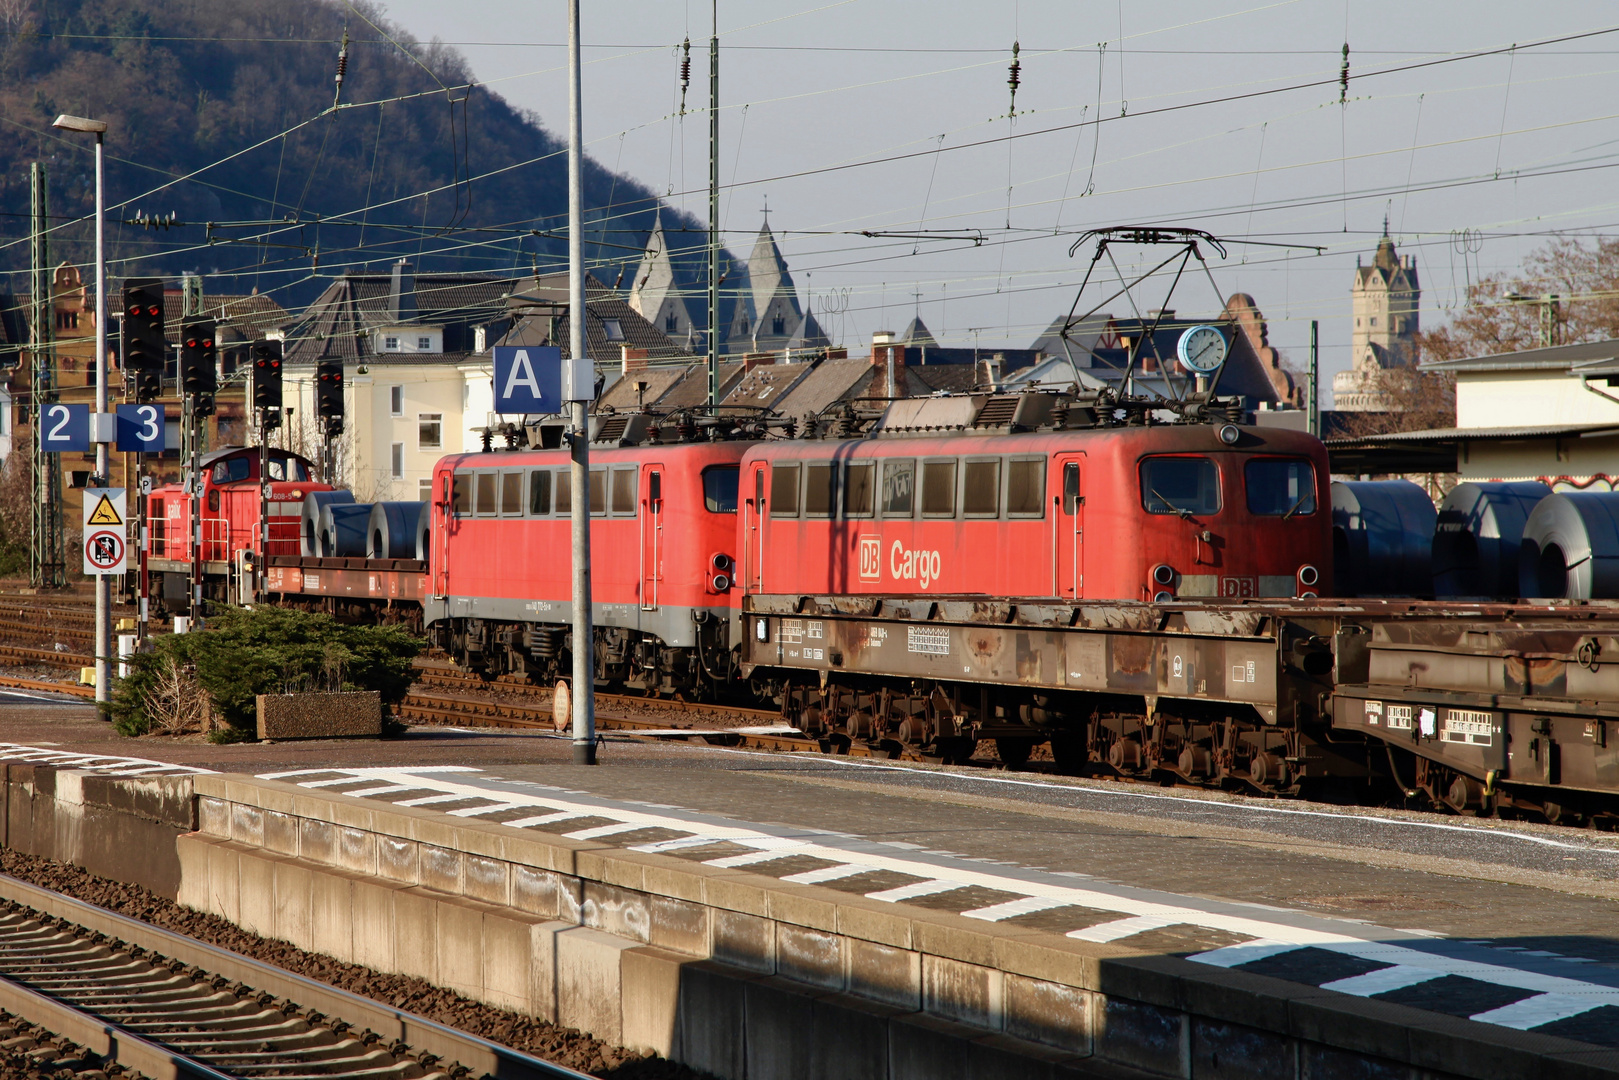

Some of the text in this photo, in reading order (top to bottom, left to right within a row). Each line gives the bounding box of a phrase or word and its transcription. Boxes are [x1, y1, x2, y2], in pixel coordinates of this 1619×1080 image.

[503, 350, 542, 399] A
[48, 405, 71, 441] 2
[135, 405, 159, 442] 3
[861, 540, 941, 589] DB Cargo
[1225, 579, 1252, 597] DB
